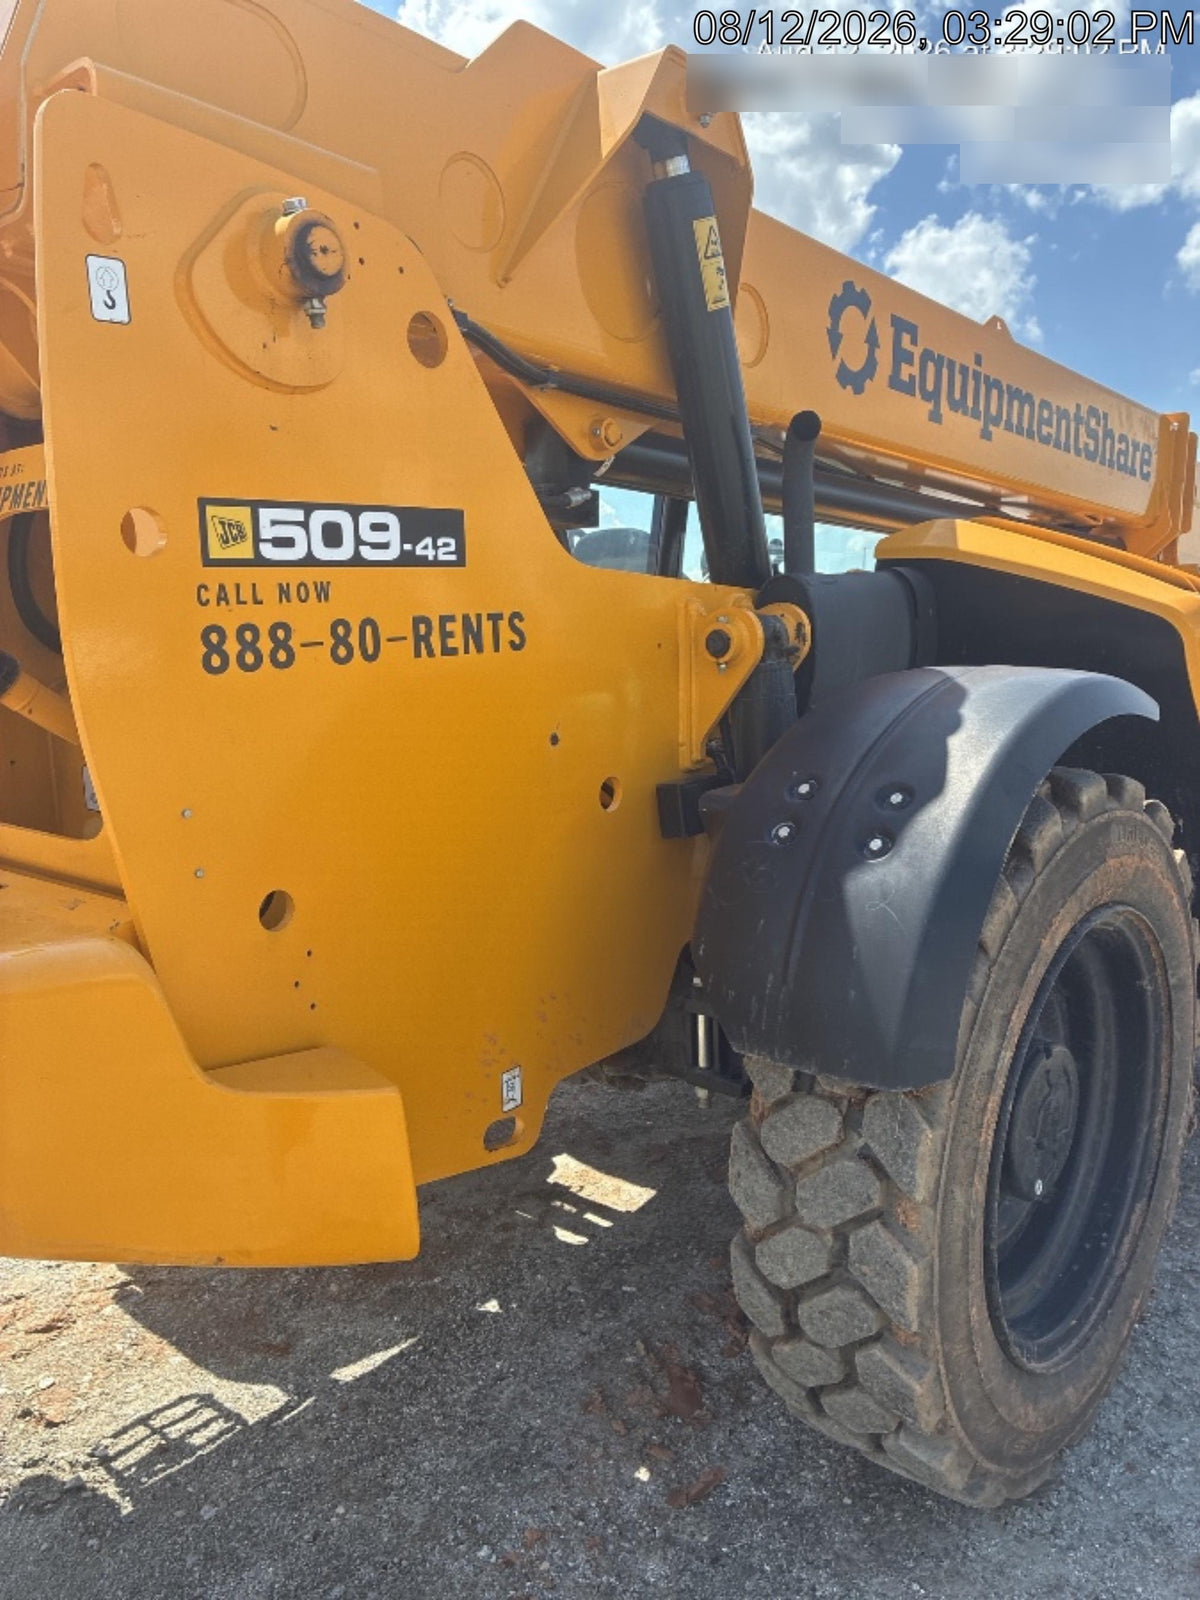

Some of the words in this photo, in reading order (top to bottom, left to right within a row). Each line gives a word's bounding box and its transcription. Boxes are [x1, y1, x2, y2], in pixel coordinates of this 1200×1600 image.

[888, 312, 1153, 482] EquipmentShare
[0, 480, 48, 513] PMEN
[215, 518, 248, 547] JCB
[258, 507, 458, 561] 509-42
[196, 582, 264, 607] CALL
[277, 580, 332, 604] NOW
[200, 611, 527, 675] 888-80-RENTS
